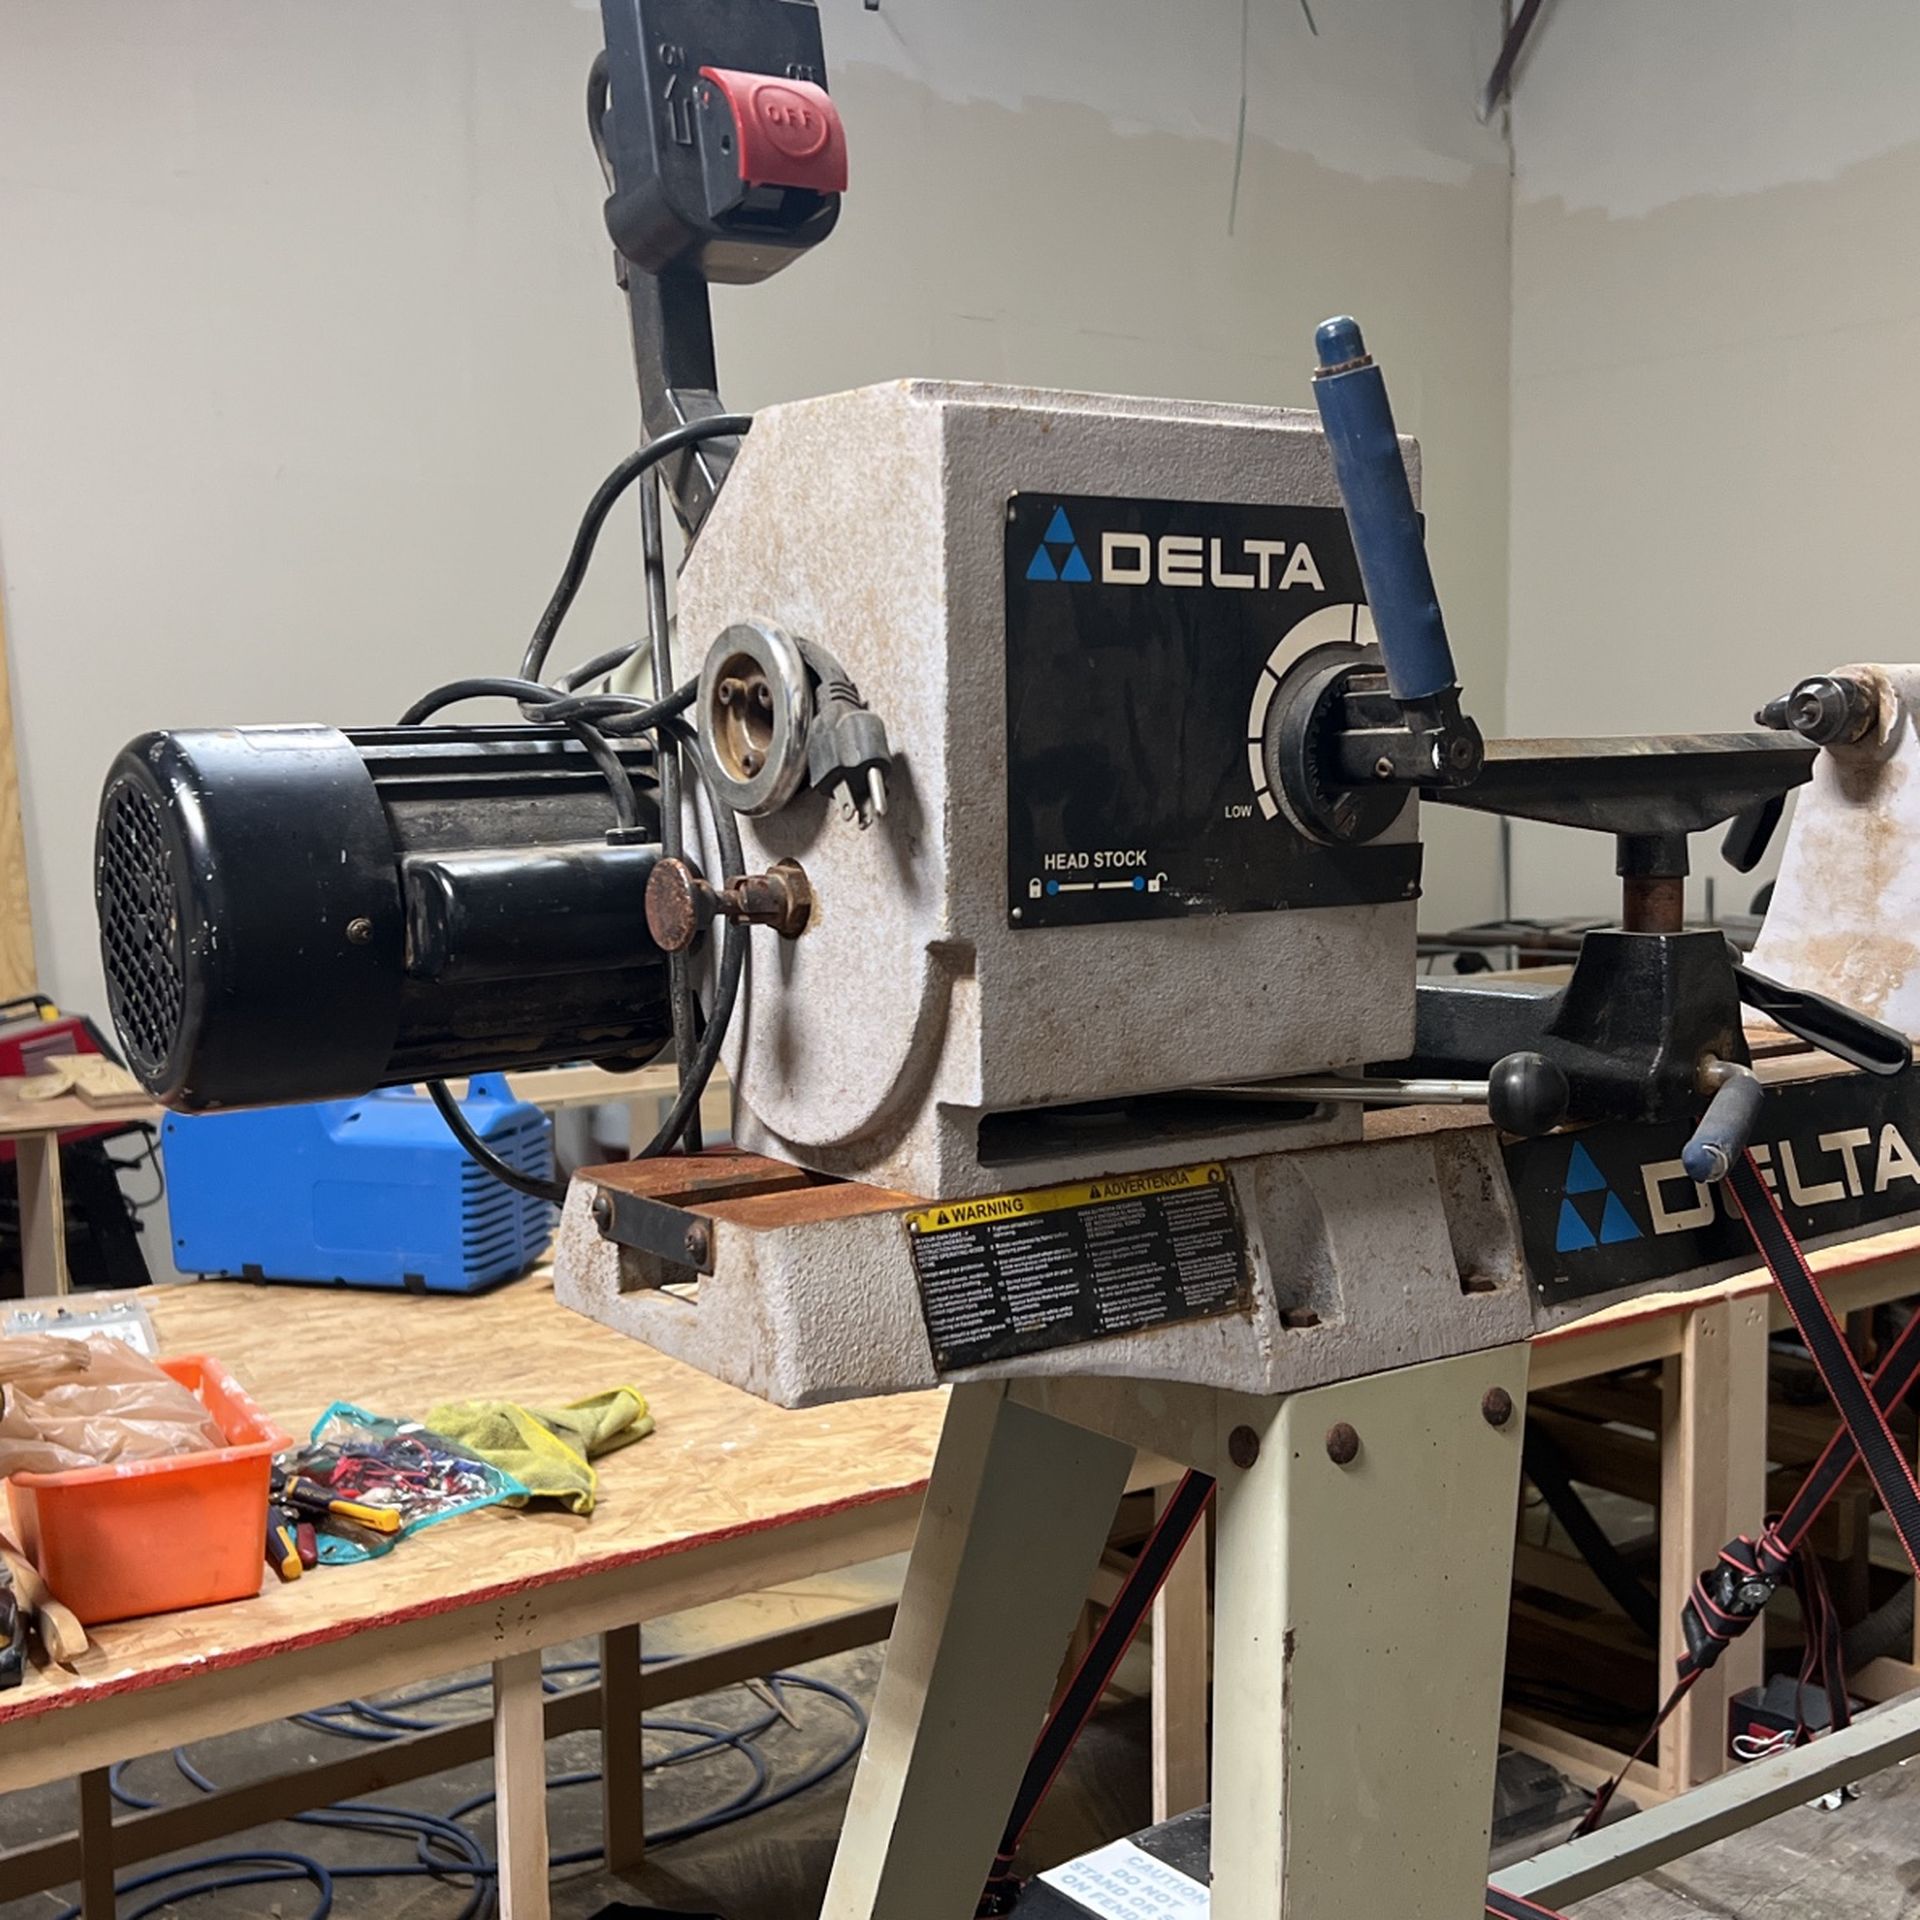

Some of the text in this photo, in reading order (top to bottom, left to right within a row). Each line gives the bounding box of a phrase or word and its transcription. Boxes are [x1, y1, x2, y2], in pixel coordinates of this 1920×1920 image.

[767, 104, 813, 130] OFF
[1101, 531, 1326, 591] DELTA
[1224, 804, 1253, 819] LOW
[1044, 849, 1148, 871] HEAD STOCK
[1103, 1170, 1191, 1198] ADVERTENCIA
[951, 1197, 1025, 1223] WARNING
[1061, 1874, 1093, 1893] ON
[1069, 1861, 1160, 1915] STAND OR
[1111, 1868, 1186, 1909] DO NOT
[1127, 1856, 1210, 1905] CAUTION
